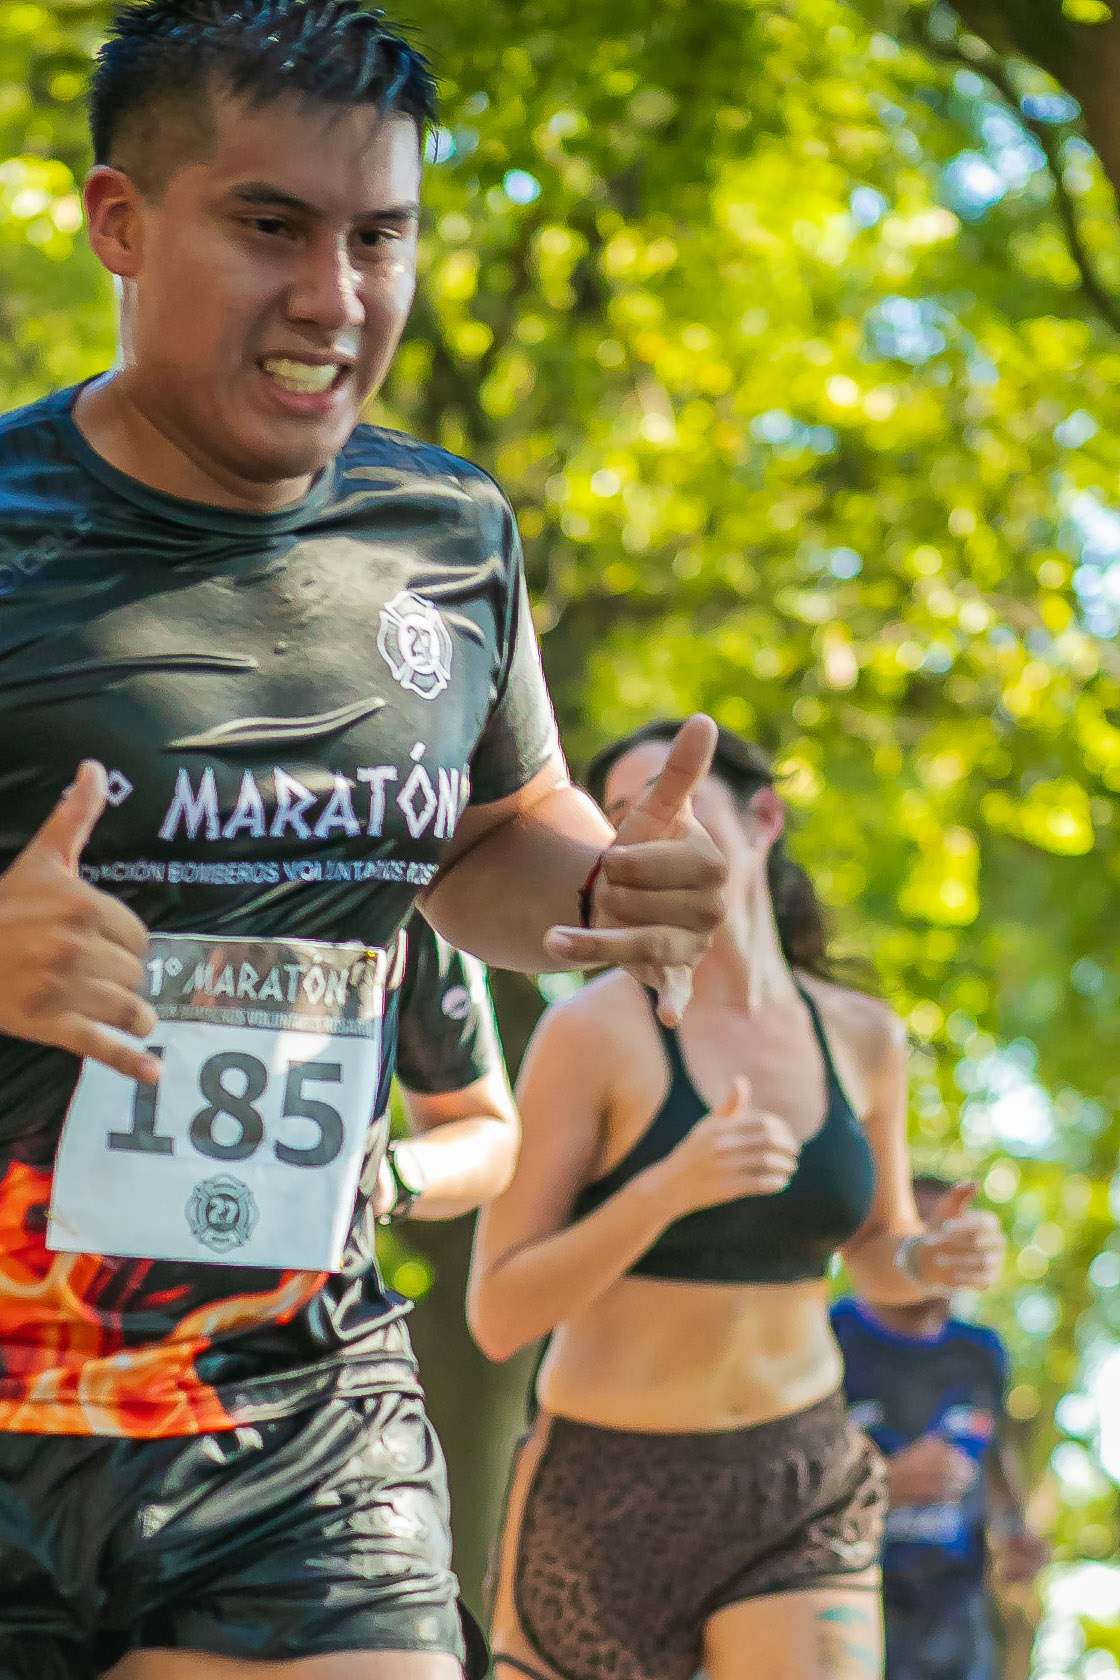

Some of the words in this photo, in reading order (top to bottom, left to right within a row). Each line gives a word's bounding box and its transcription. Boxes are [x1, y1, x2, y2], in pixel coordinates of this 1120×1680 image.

[158, 741, 470, 841] MARATÓN
[146, 956, 183, 997] 1°
[182, 953, 349, 1007] MARATÓN
[106, 1045, 346, 1169] 185
